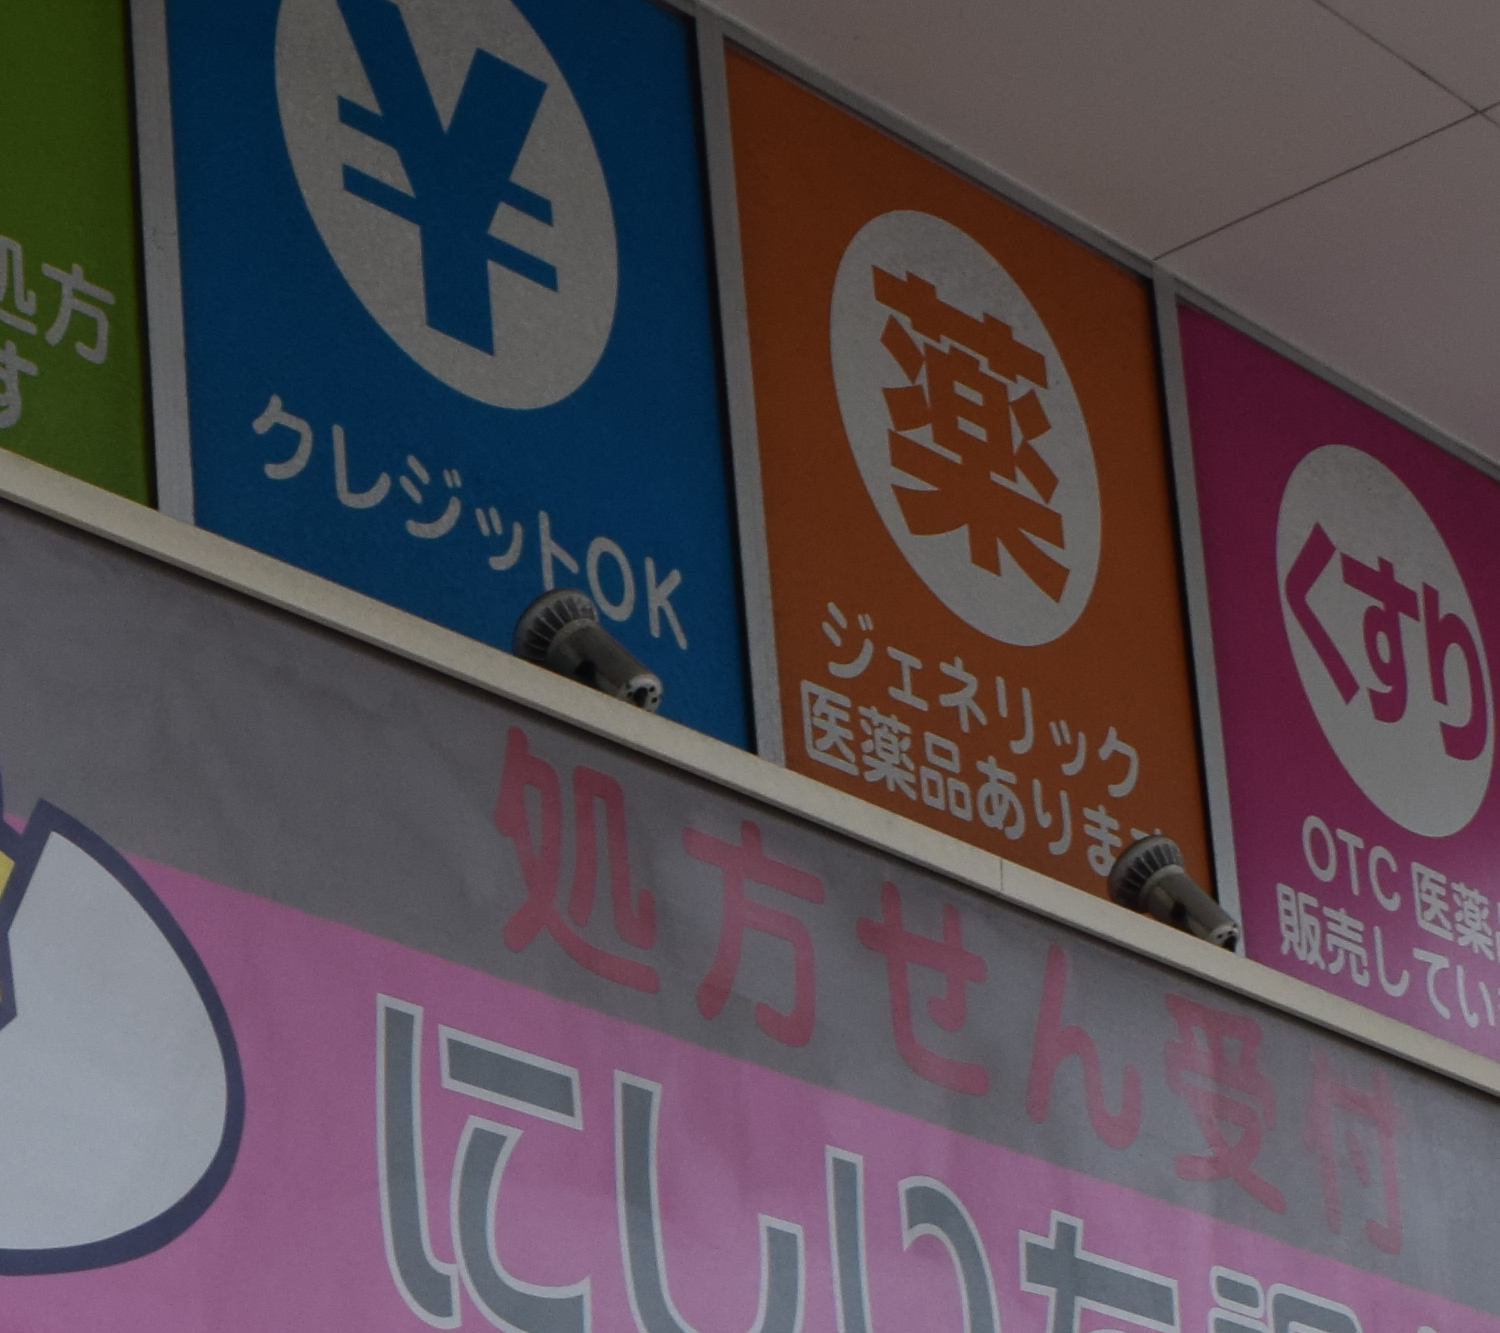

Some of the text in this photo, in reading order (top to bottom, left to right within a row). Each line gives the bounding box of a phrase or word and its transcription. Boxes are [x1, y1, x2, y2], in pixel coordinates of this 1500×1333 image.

[252, 393, 687, 649] クレジットOK
[871, 263, 1071, 603] 薬
[820, 601, 1139, 798] ジェネリック
[1284, 522, 1489, 761] くすり
[800, 681, 1162, 878] 医薬品ありま
[1302, 814, 1401, 912] OTC
[492, 725, 1402, 1257] 処方せん受付
